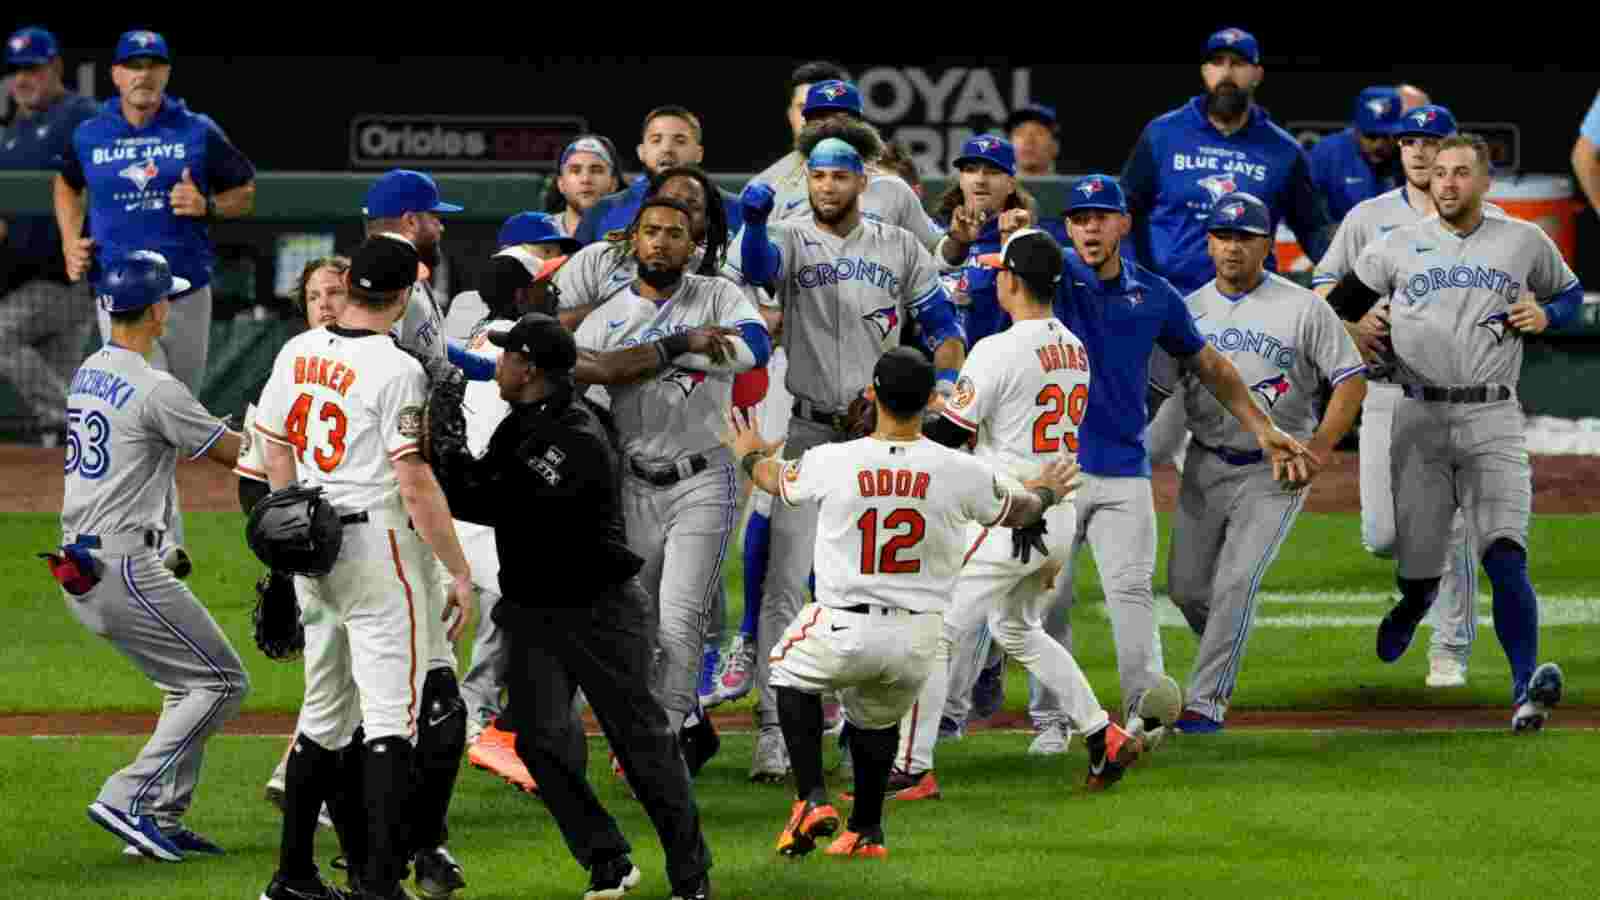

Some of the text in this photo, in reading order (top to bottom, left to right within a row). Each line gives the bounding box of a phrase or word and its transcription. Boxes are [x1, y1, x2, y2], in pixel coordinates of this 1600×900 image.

[861, 66, 1030, 124] OYAL
[92, 143, 186, 165] BLUE JAYS
[359, 124, 487, 156] Orioles
[1173, 152, 1266, 181] BLUE JAYS
[797, 257, 903, 300] ORONTO
[293, 356, 356, 397] BAKER
[284, 392, 347, 474] 43
[1031, 383, 1089, 454] 29
[63, 408, 111, 479] 53
[857, 468, 930, 499] ODOR
[857, 507, 925, 575] 12
